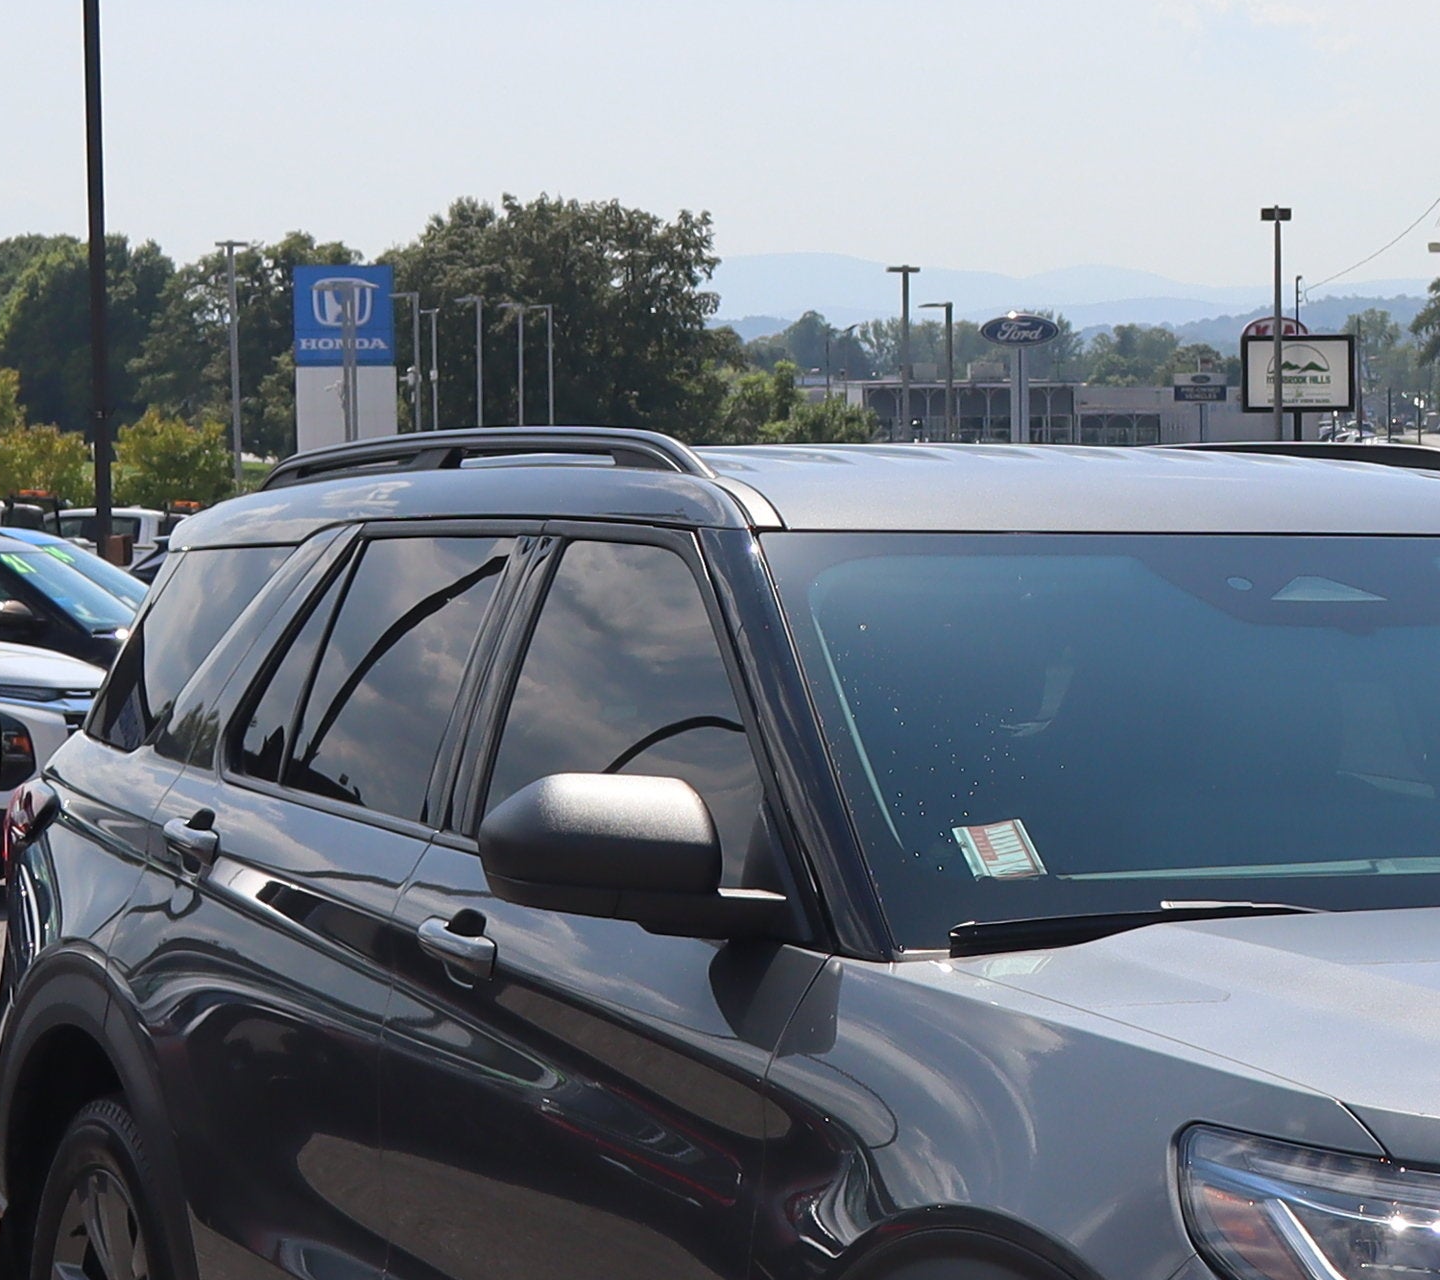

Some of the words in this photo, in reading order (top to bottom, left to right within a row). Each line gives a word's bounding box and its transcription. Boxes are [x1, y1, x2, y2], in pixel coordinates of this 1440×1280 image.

[997, 321, 1044, 340] Ford
[1255, 324, 1295, 335] KA
[1309, 375, 1331, 385] HILLS
